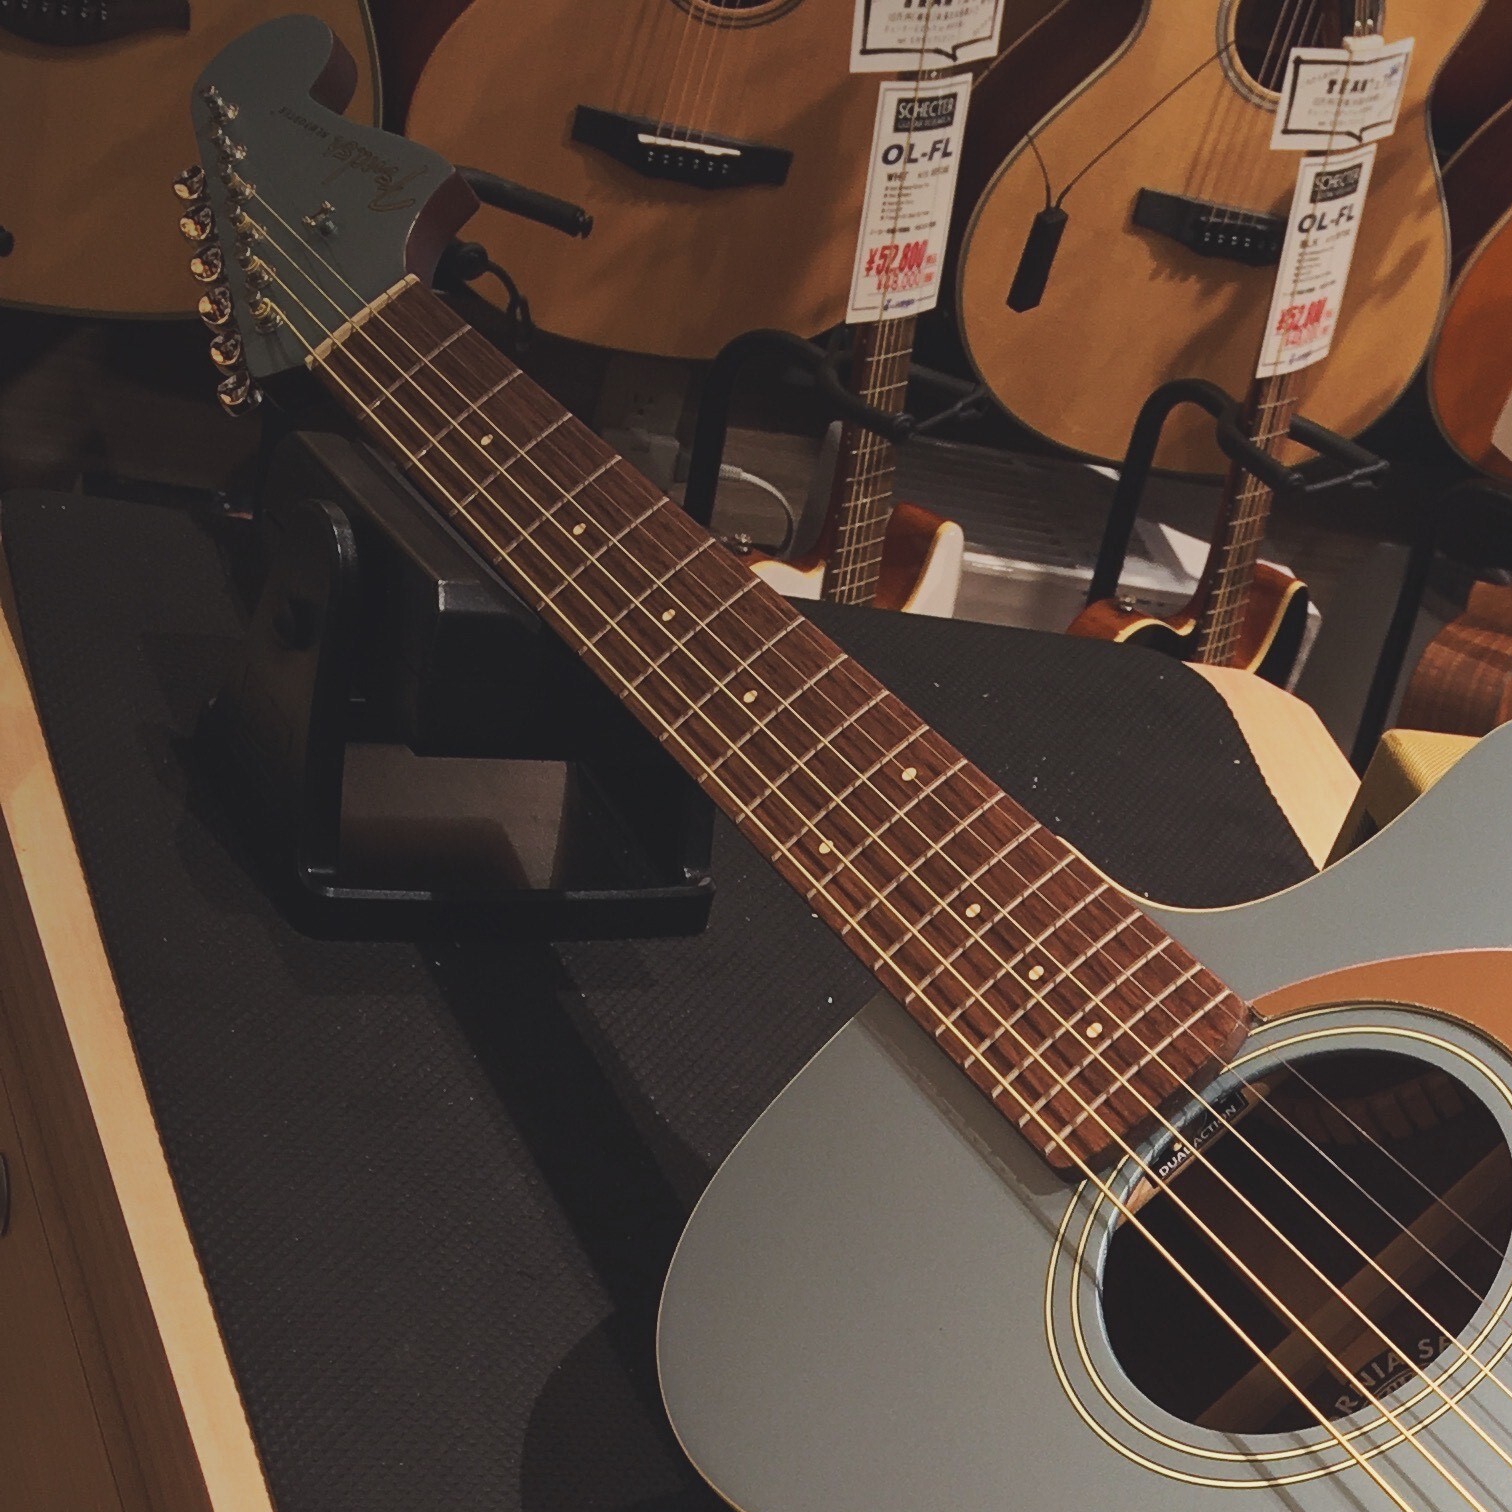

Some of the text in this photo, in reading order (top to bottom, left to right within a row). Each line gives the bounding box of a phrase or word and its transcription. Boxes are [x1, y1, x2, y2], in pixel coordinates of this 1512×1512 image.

[882, 137, 953, 166] OL-FL
[1297, 202, 1355, 234] OL-FL
[1158, 1146, 1192, 1177] DUAL
